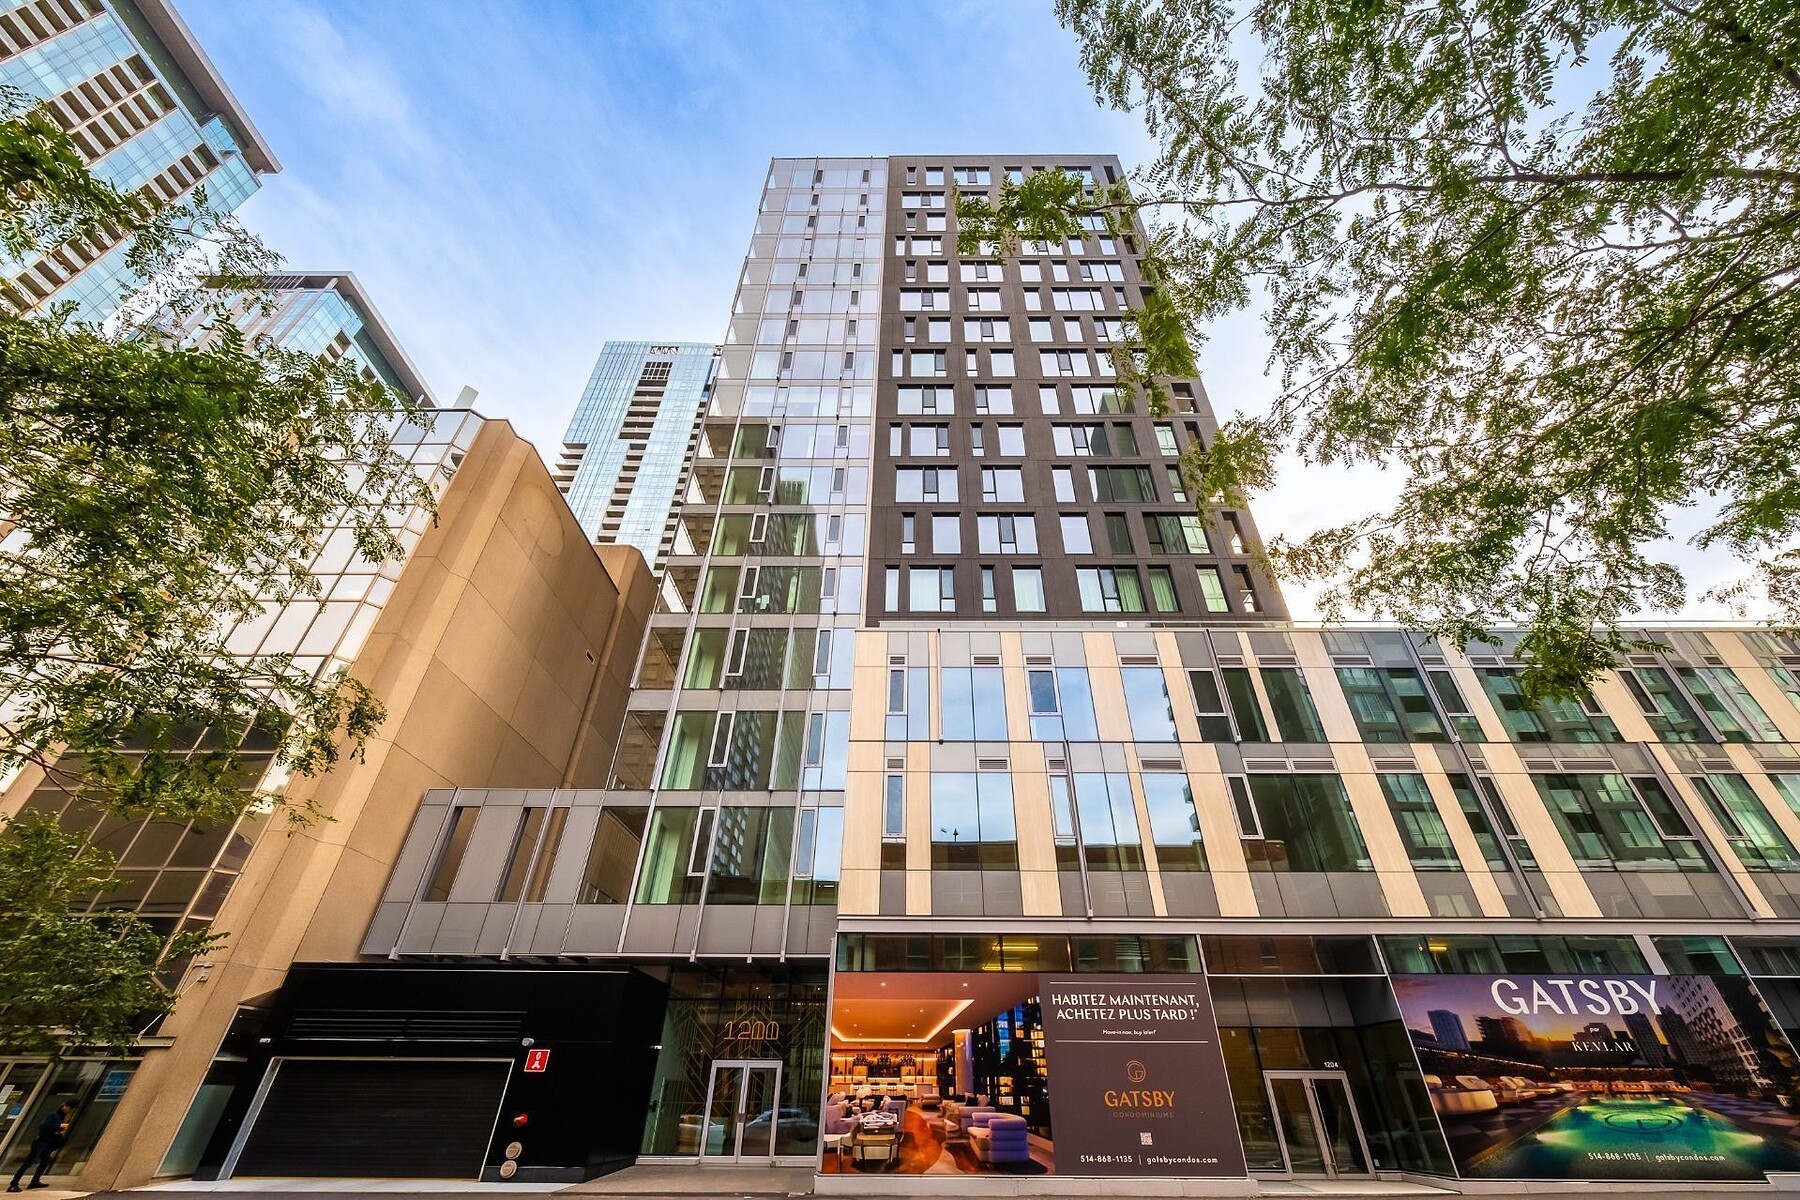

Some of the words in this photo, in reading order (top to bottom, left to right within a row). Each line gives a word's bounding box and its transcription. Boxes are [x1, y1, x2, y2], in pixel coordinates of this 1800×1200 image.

[1051, 993, 1107, 1006] HABITEZ
[1109, 993, 1200, 1008] MAINTENANT,
[1491, 978, 1662, 1016] GATSBY
[1056, 1008, 1115, 1020] ACHETEZ
[1119, 1008, 1151, 1021] PLUS
[1153, 1009, 1188, 1020] TARD
[723, 1020, 780, 1040] 1200
[1589, 1026, 1600, 1034] par
[1572, 1041, 1635, 1052] KEVLAR
[1104, 1090, 1175, 1107] GATSBY
[1080, 1154, 1133, 1163] 514-868-1135
[1146, 1156, 1219, 1165] gatsbycondos.com
[1587, 1152, 1642, 1161] 514-868-1135
[1655, 1154, 1726, 1163] gatsbycondos.com
